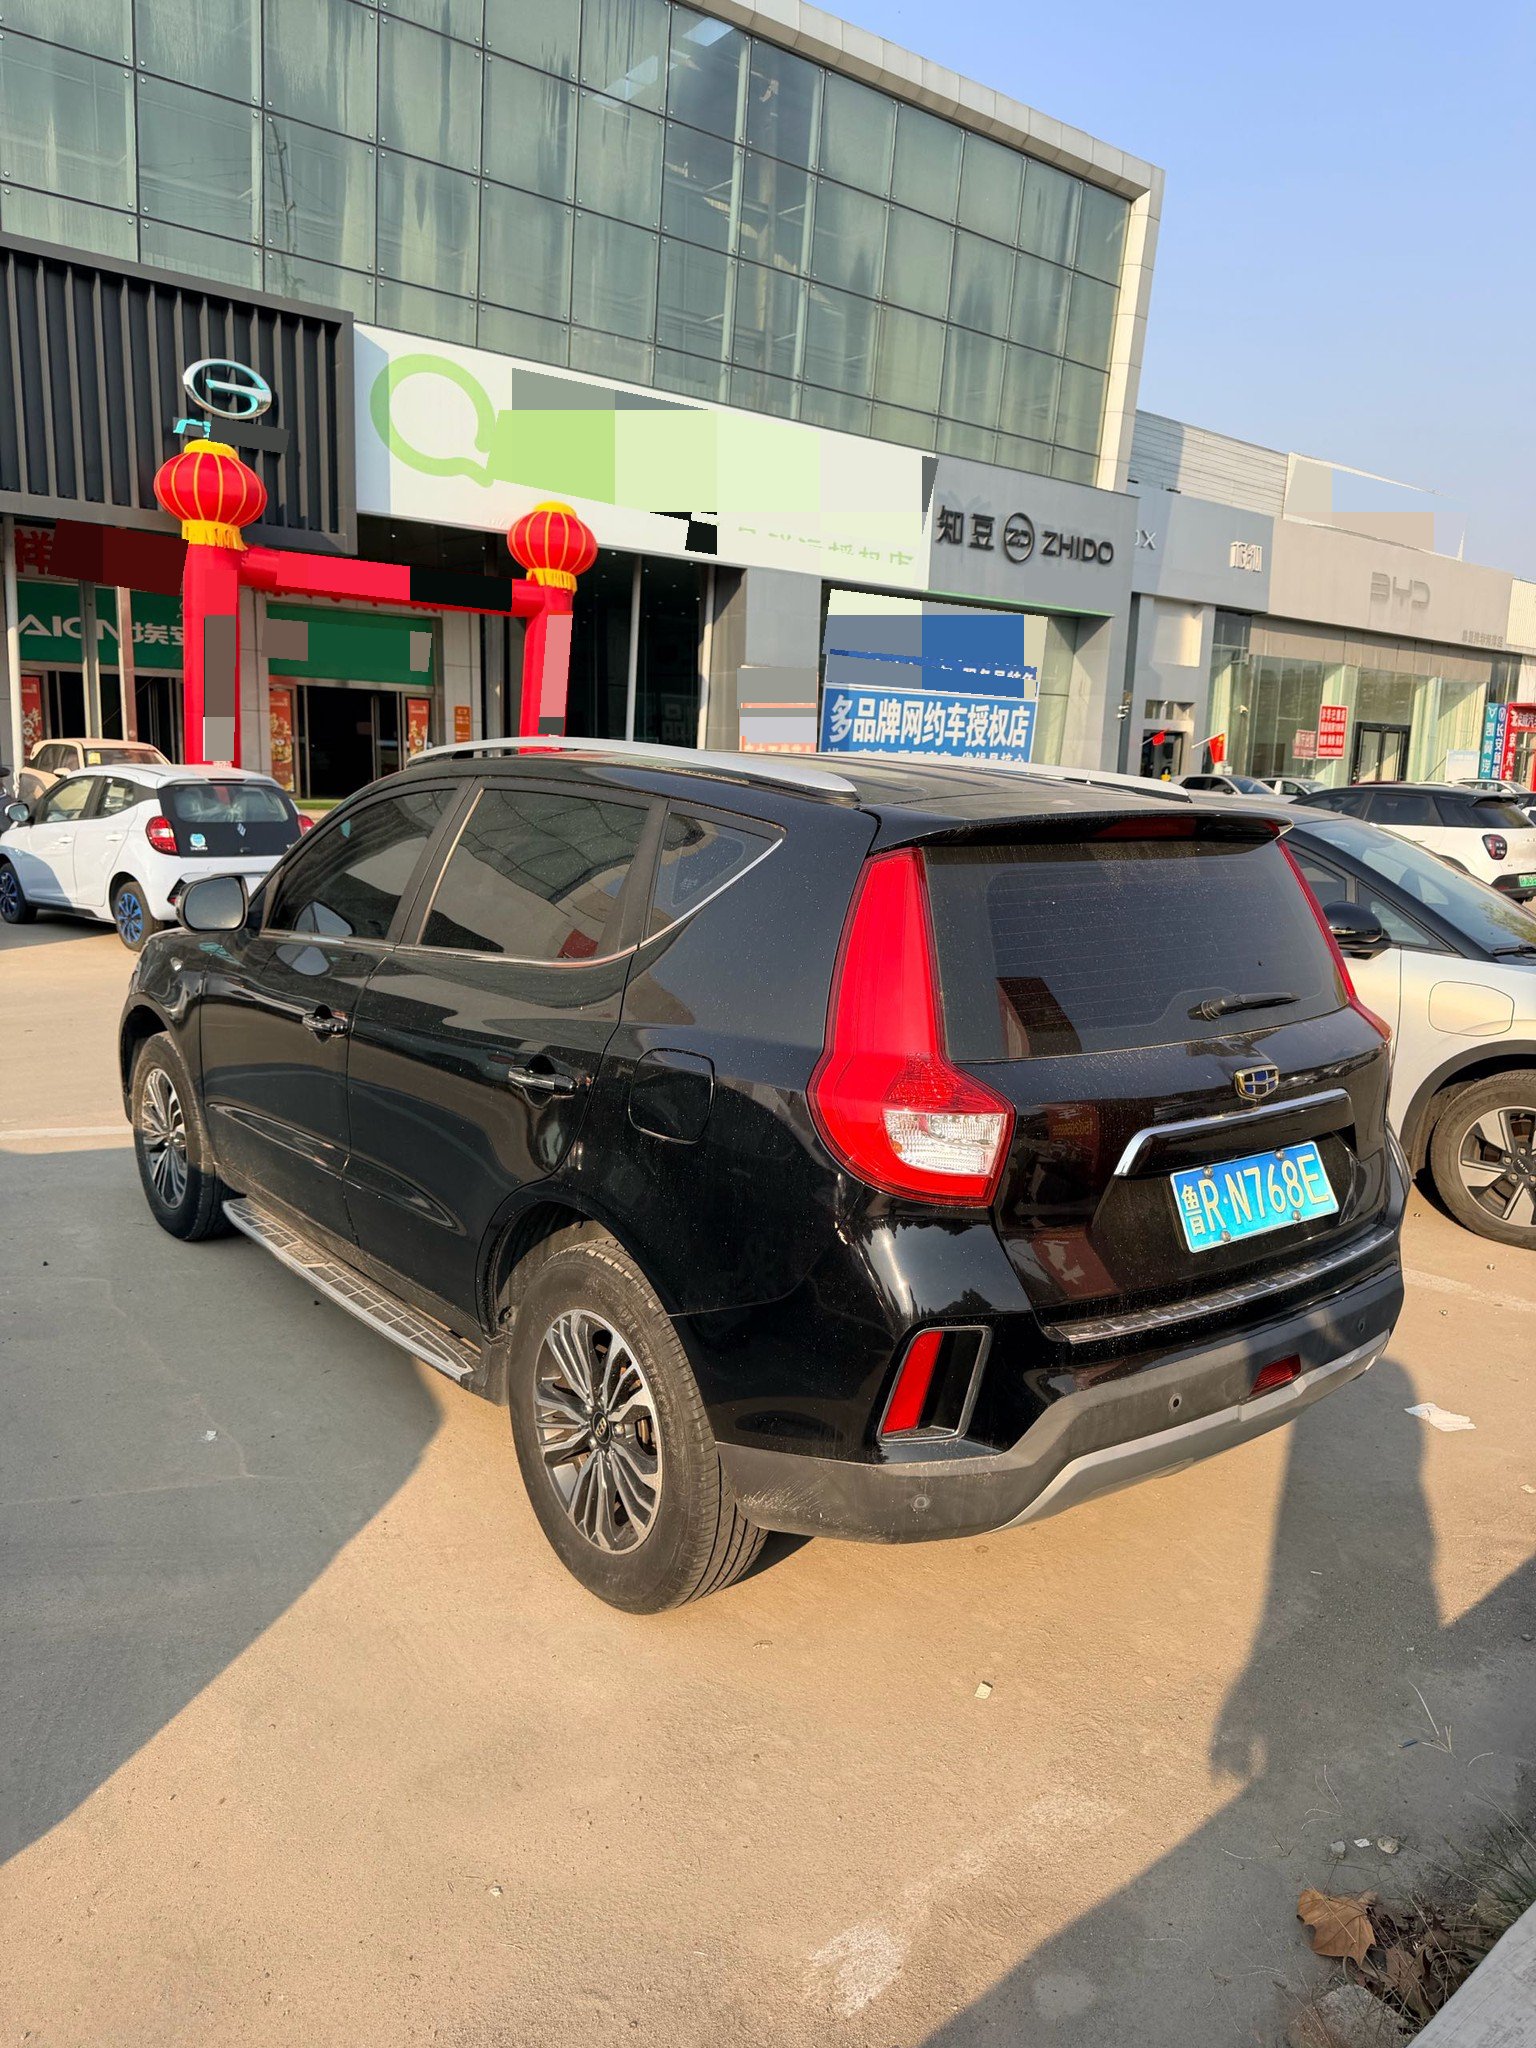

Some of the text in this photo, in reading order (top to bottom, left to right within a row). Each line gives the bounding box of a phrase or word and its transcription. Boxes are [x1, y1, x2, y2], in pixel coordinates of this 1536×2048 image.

[935, 505, 995, 550] 知豆
[1041, 530, 1114, 564] ZHIDO
[1370, 572, 1431, 609] BYD
[829, 694, 1030, 748] 多品牌网约车授权店
